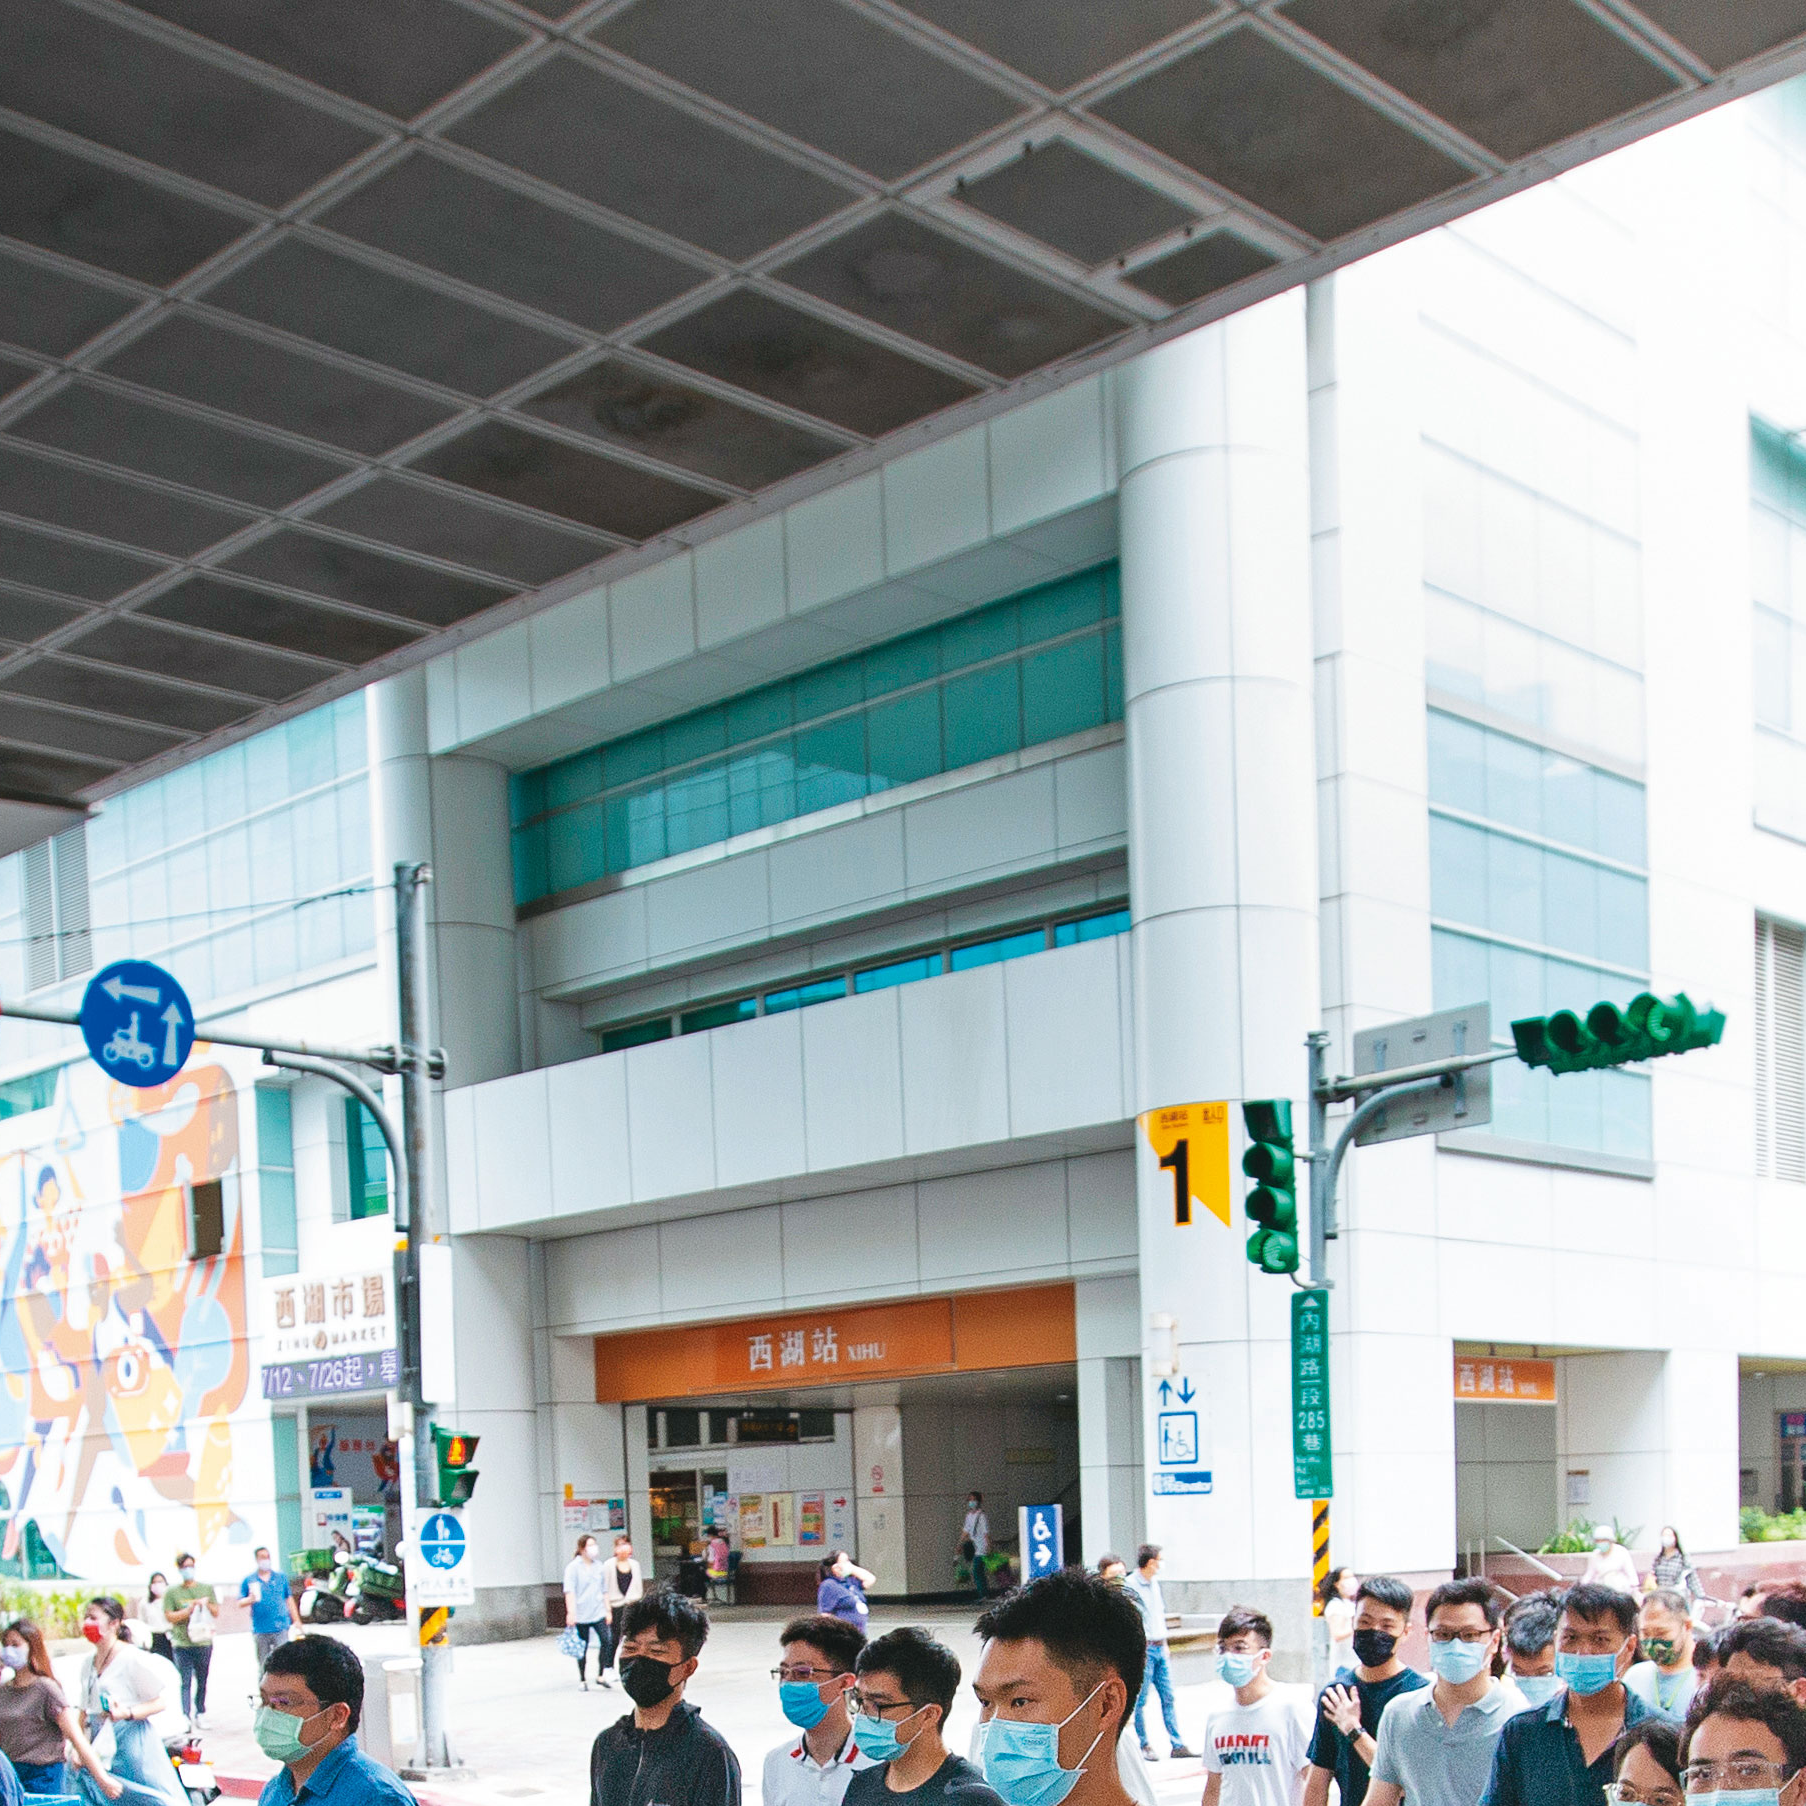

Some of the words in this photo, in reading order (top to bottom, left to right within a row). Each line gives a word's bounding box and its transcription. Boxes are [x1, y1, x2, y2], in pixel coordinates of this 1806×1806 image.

[1160, 1139, 1190, 1223] 1
[274, 1274, 386, 1328] 西湖市場
[331, 1325, 387, 1346] MARKET
[747, 1325, 839, 1371] 西湖站
[846, 1342, 887, 1362] XIHU
[1458, 1363, 1516, 1394] 西湖站
